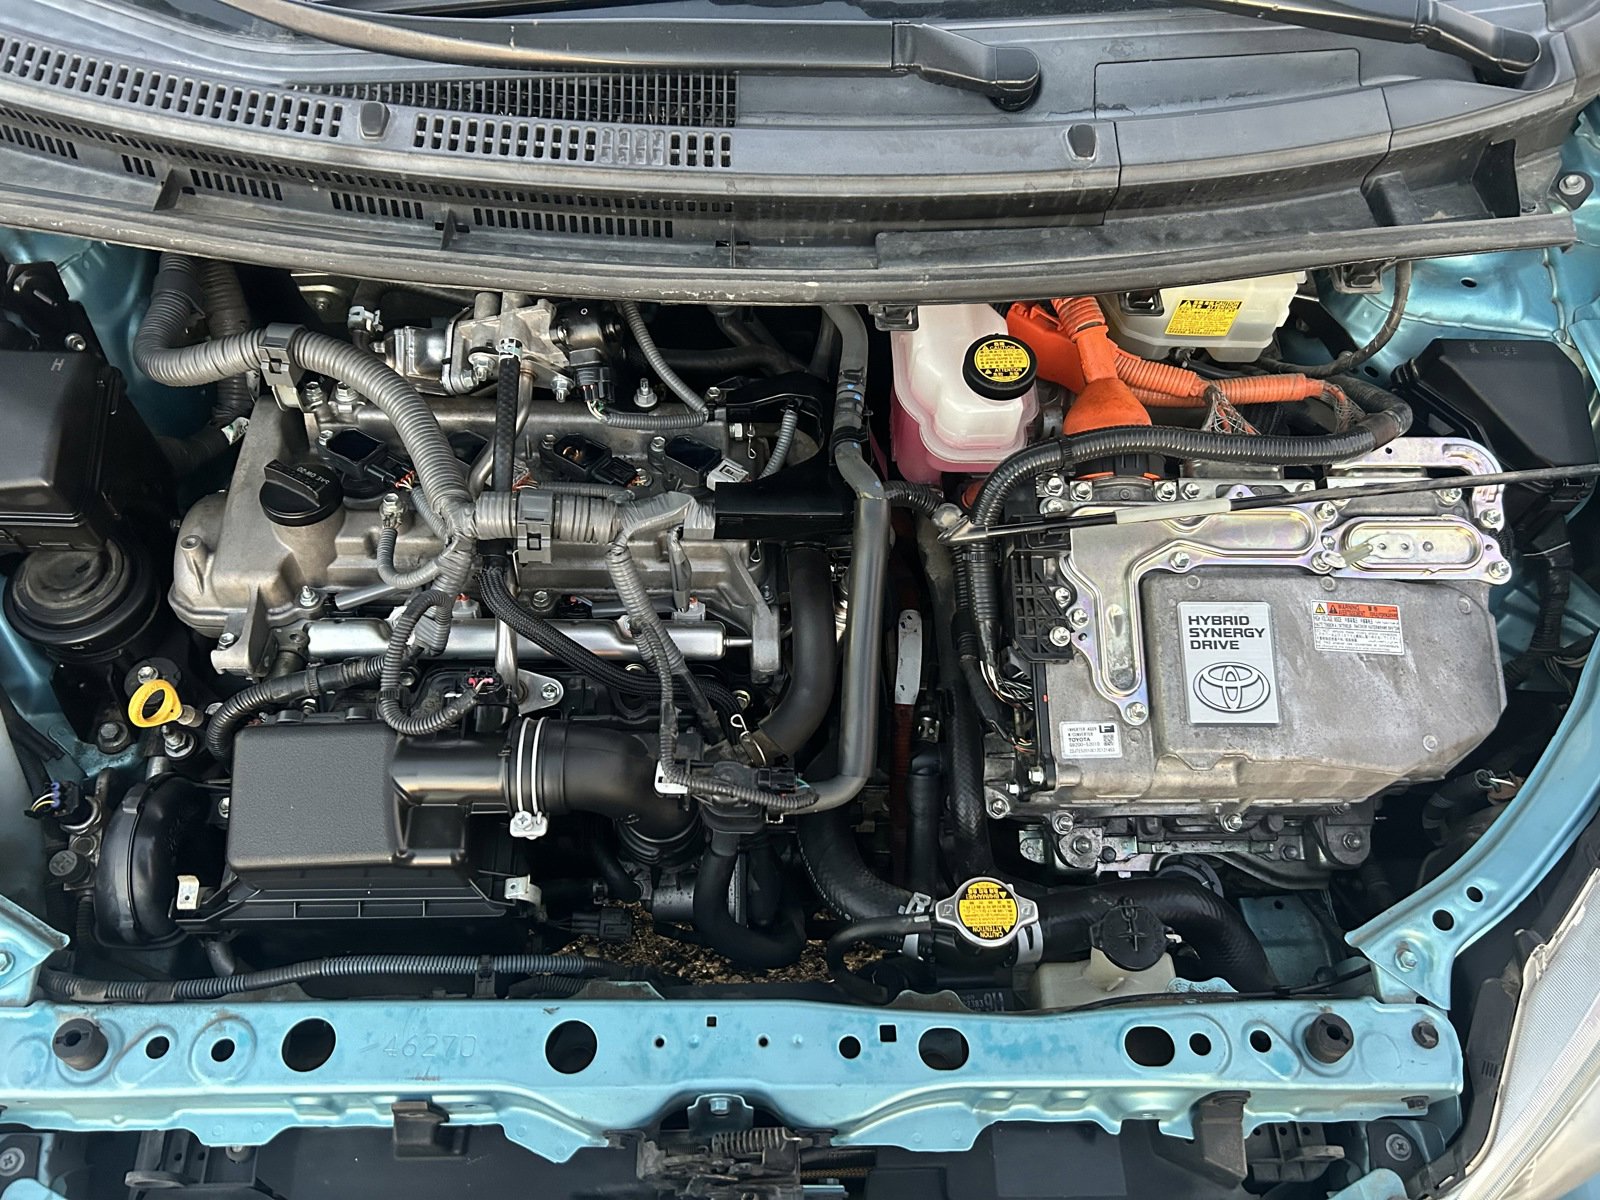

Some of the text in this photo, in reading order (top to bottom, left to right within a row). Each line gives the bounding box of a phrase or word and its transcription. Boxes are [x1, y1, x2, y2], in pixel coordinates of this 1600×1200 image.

[1188, 615, 1250, 626] HYBRID
[1189, 627, 1266, 638] SYNERGY
[1190, 640, 1240, 650] DRIVE
[382, 1033, 477, 1058] 46270
